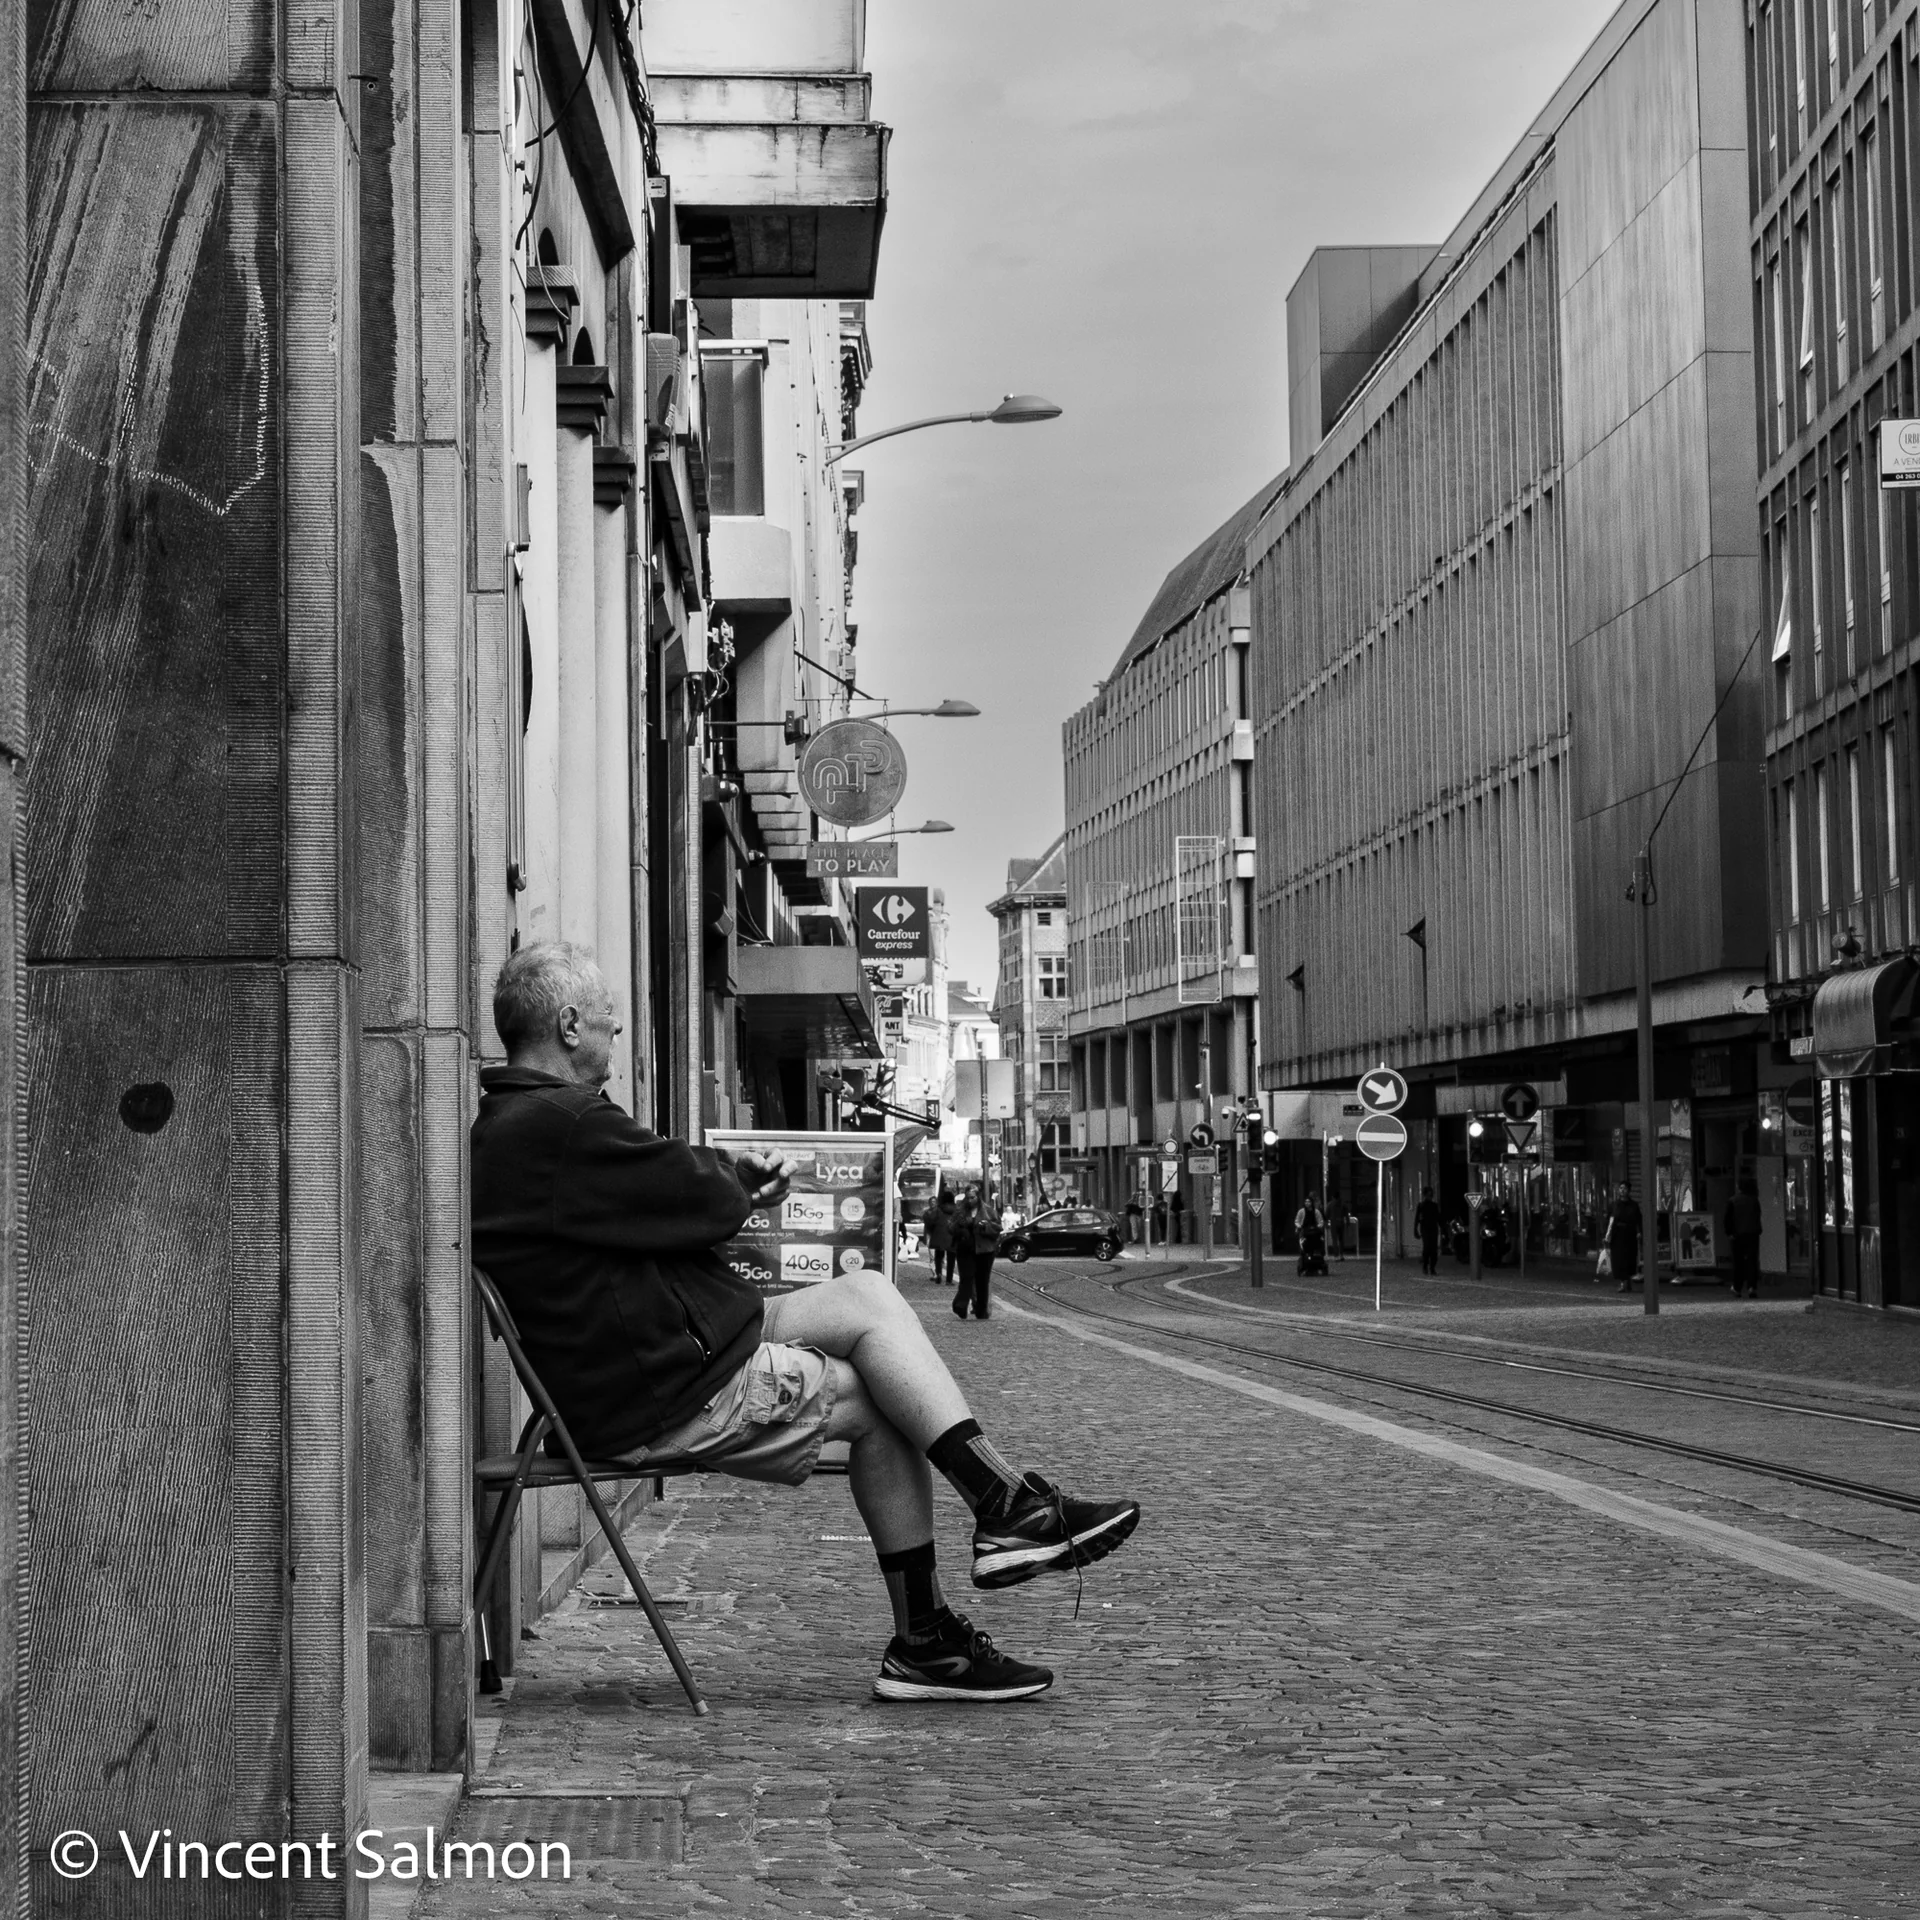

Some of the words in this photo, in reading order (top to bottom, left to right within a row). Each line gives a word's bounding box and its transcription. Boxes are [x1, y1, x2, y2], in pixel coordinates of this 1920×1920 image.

[814, 859, 839, 872] TO
[847, 859, 890, 872] PLAY
[867, 928, 921, 940] Carrefour
[875, 940, 913, 951] express
[816, 1163, 863, 1183] Lyca
[786, 1202, 824, 1220] 15Go
[785, 1254, 830, 1271] 40Go
